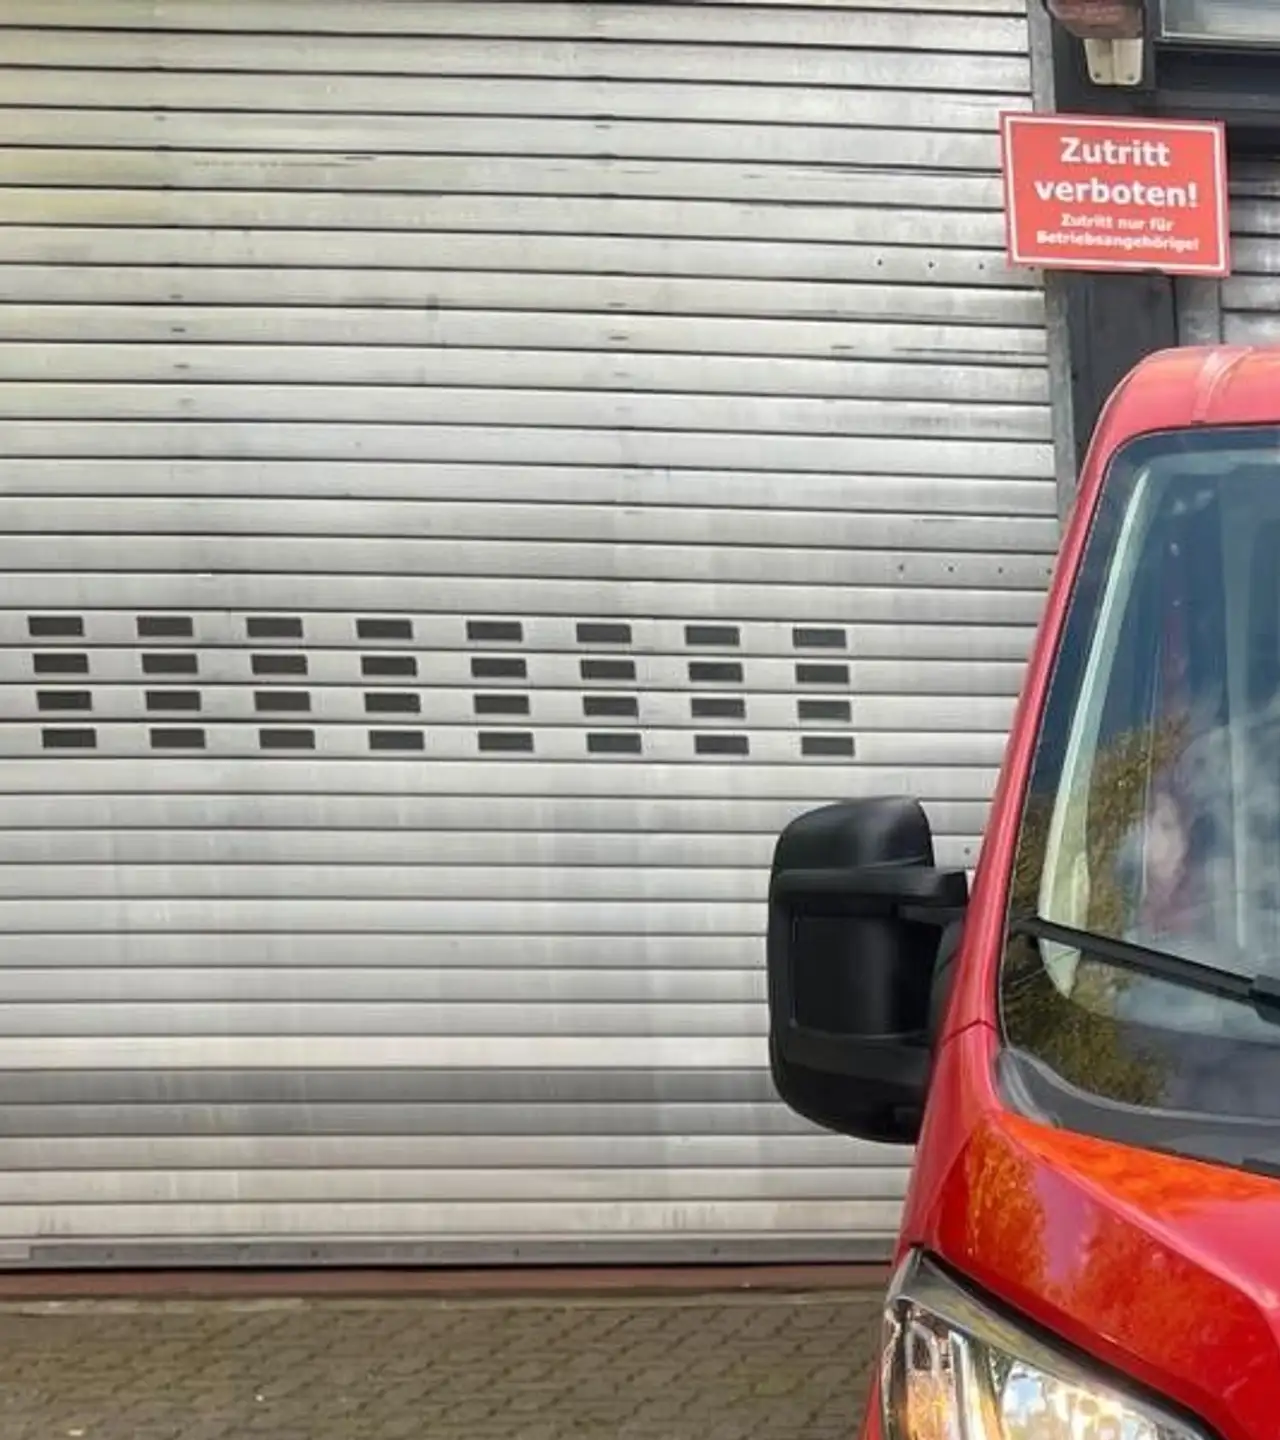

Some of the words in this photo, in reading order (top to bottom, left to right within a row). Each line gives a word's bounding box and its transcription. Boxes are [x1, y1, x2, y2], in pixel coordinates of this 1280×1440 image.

[1060, 136, 1171, 167] Zutritt
[1034, 177, 1199, 208] verboten!
[1060, 212, 1114, 231] Zutritt
[1118, 218, 1145, 231] nur
[1149, 216, 1175, 232] für
